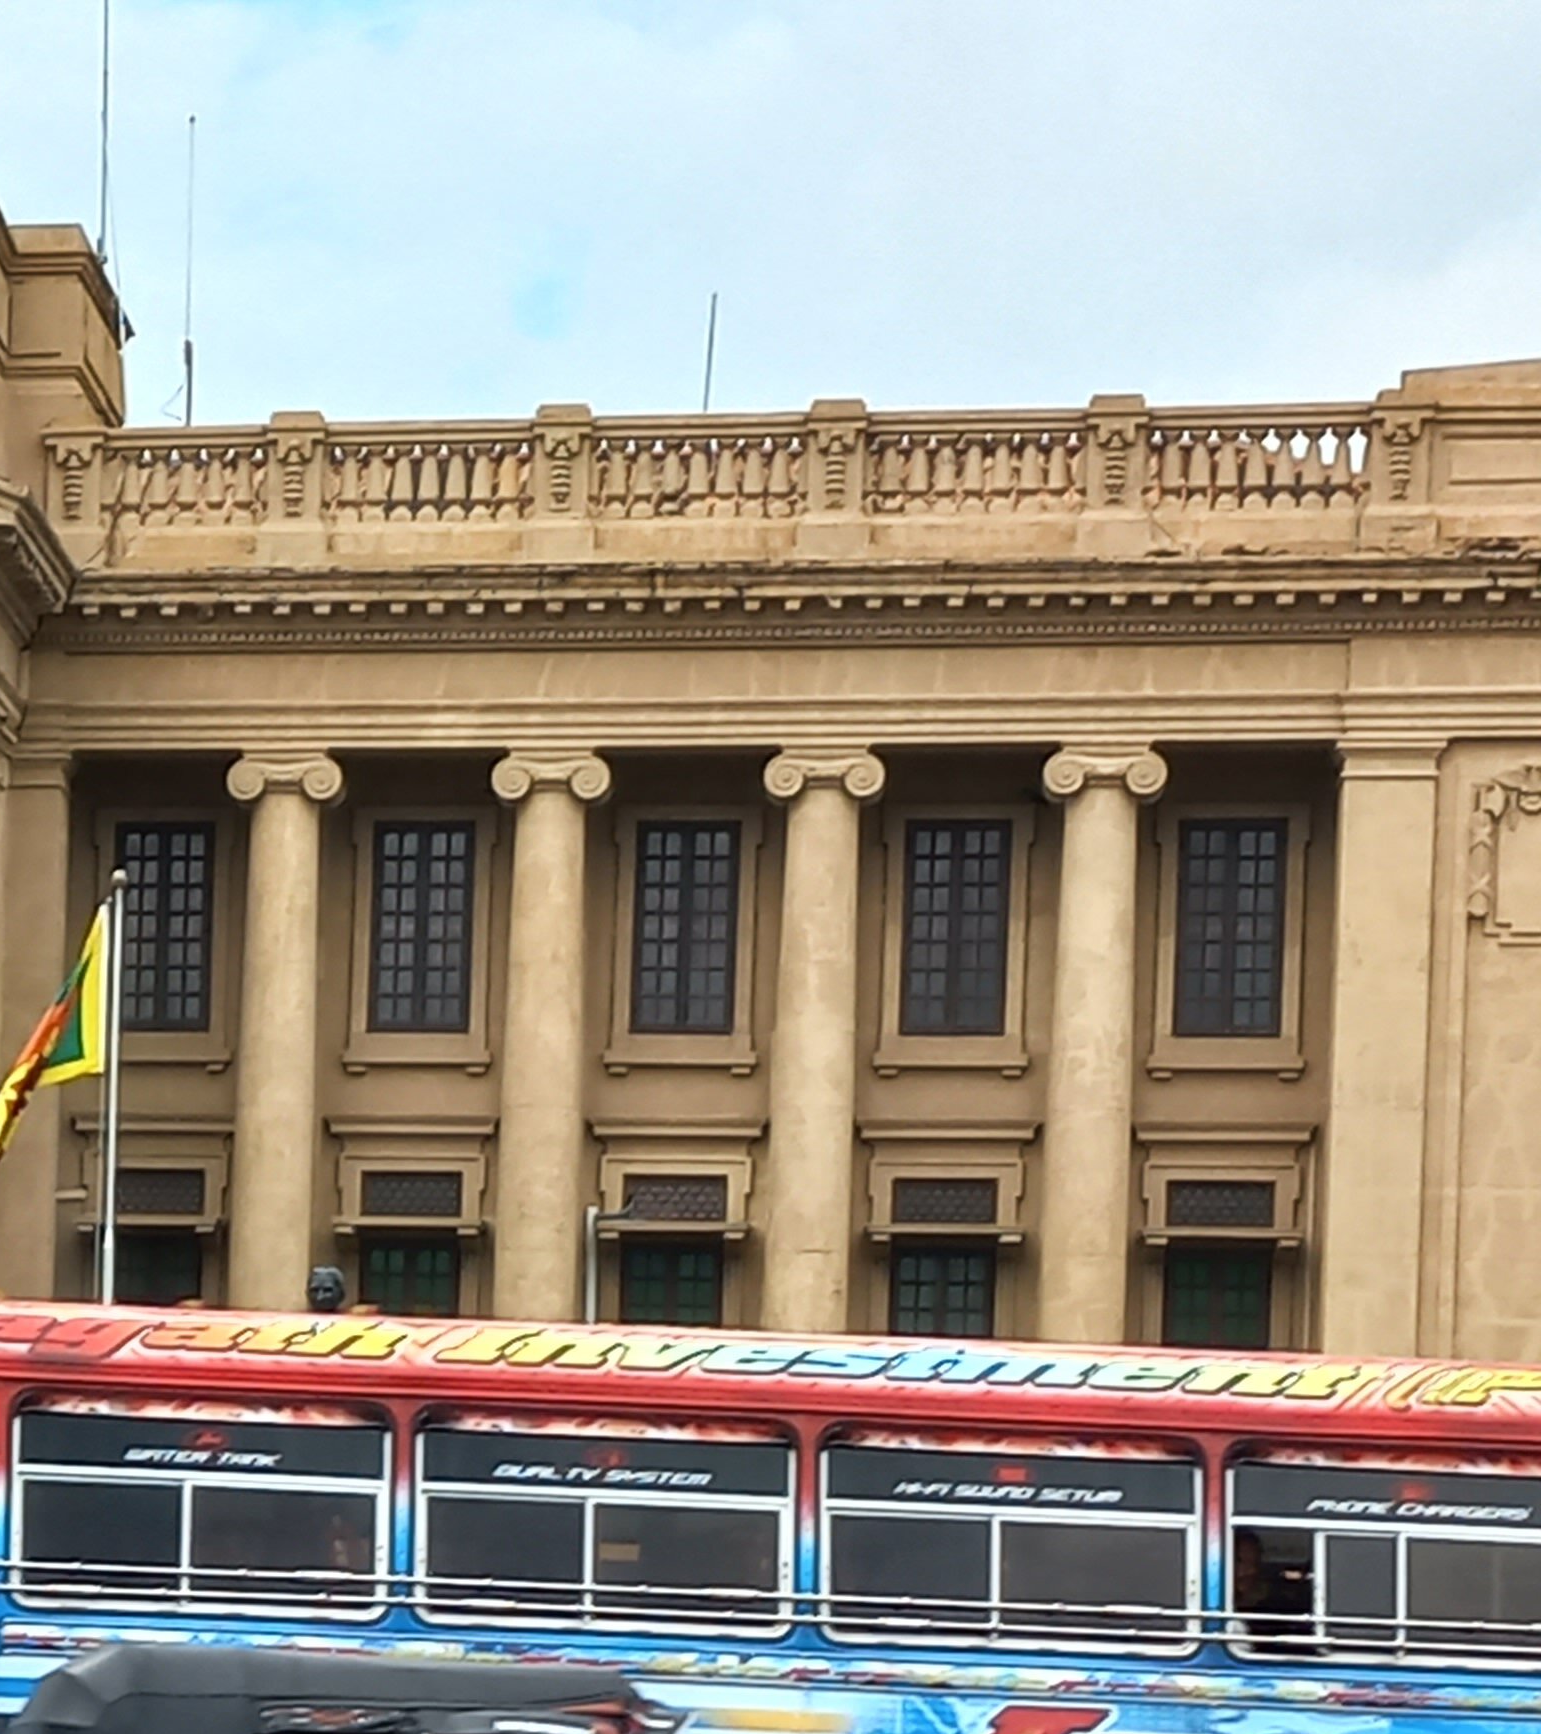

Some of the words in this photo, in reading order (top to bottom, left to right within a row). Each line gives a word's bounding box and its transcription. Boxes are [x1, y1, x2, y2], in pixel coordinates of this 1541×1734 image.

[434, 1325, 1360, 1400] Investment
[123, 1448, 211, 1464] WATER
[216, 1451, 282, 1467] TANK
[603, 1469, 713, 1486] SYSTEM
[892, 1481, 953, 1497] HI-FI
[953, 1484, 1035, 1501] SOUND
[1036, 1487, 1123, 1503] SETUP
[1306, 1499, 1395, 1514] PHONE
